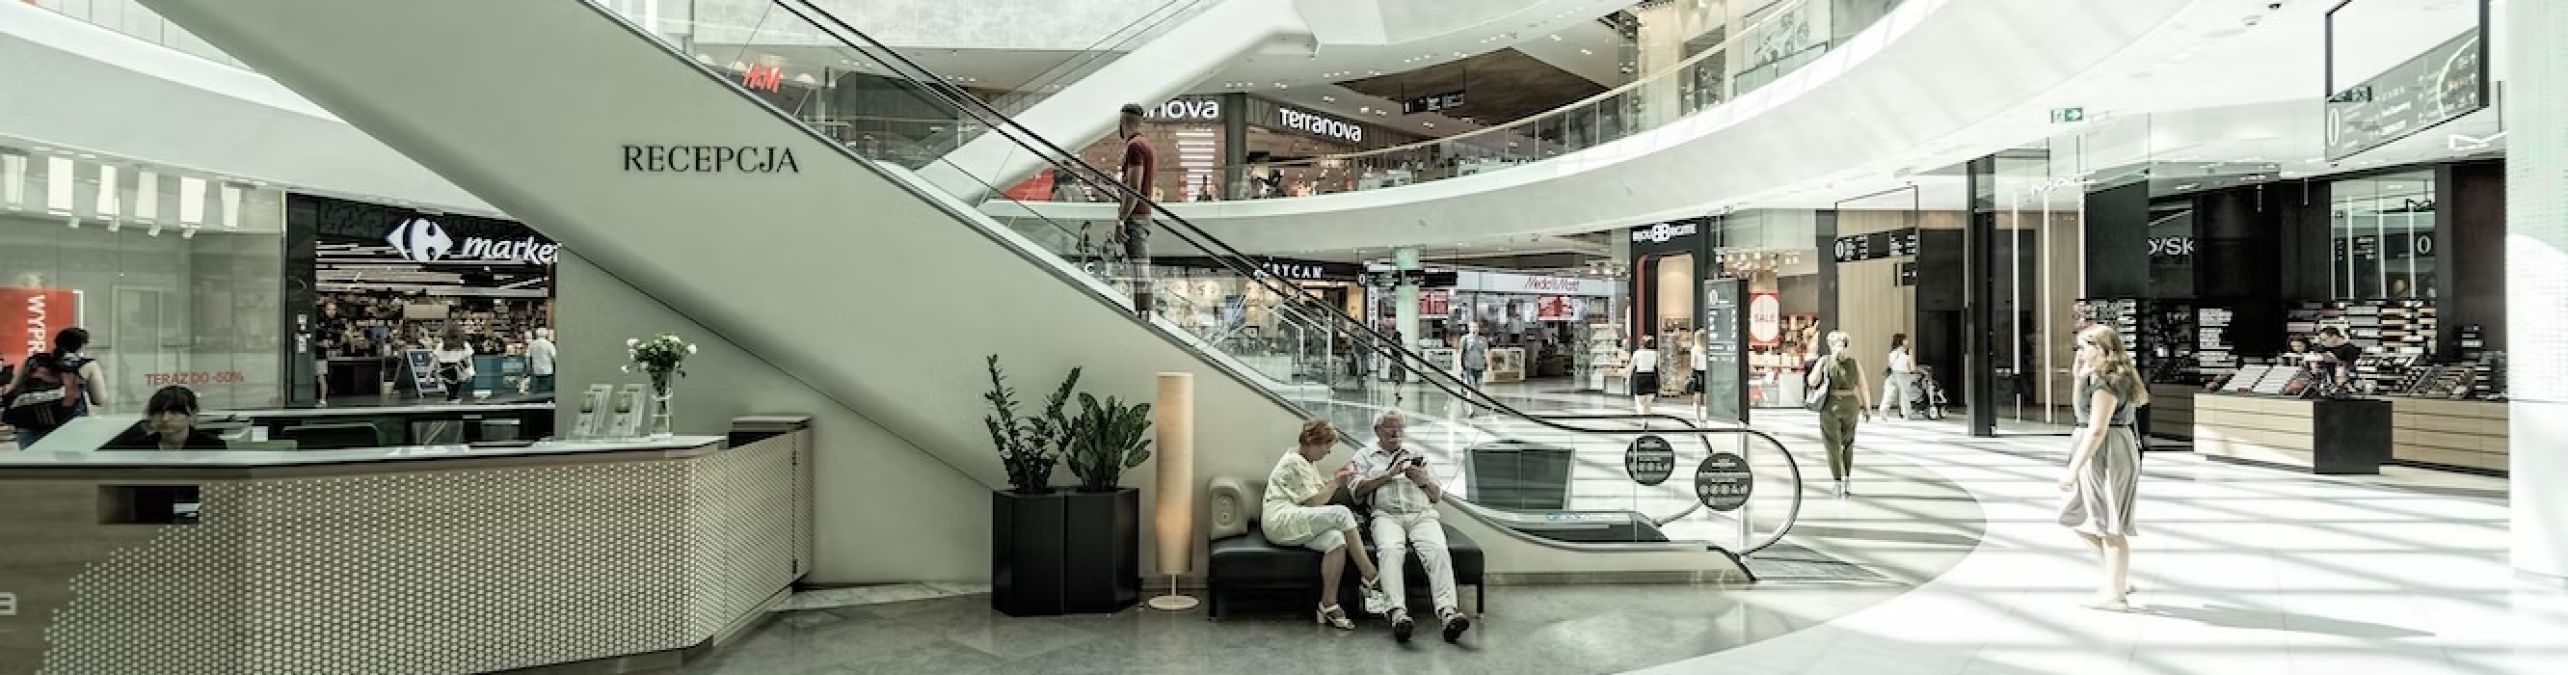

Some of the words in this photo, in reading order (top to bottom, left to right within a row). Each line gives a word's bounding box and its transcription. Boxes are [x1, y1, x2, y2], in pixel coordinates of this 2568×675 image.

[1279, 107, 1362, 142] Terranova
[622, 145, 799, 173] RECEPCJA
[143, 373, 189, 386] TERAZ
